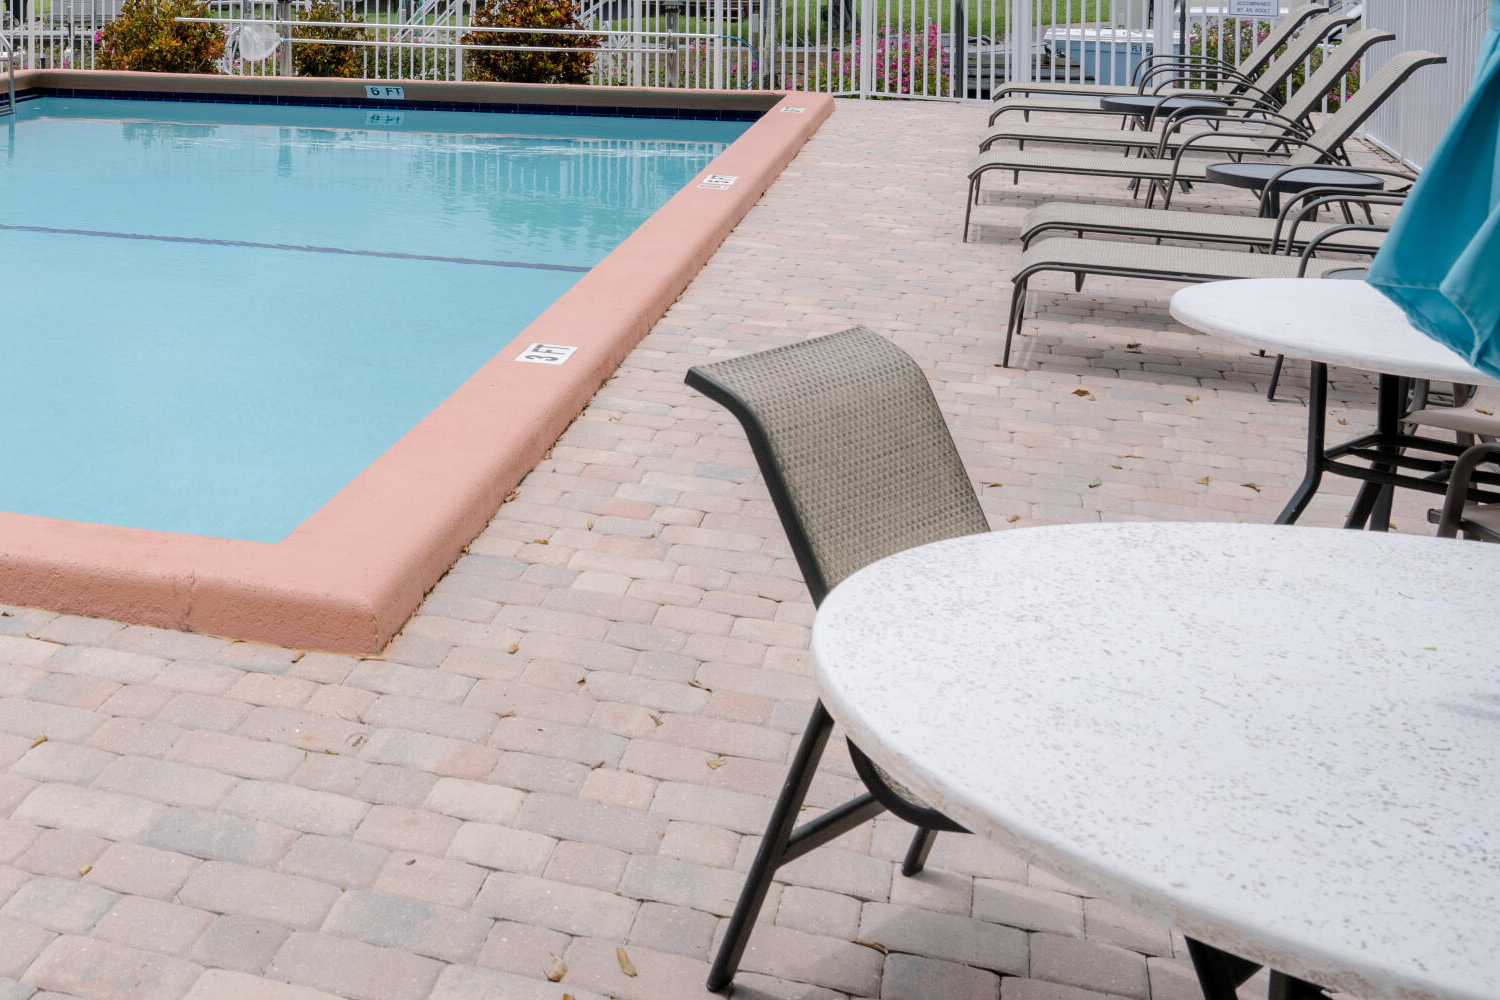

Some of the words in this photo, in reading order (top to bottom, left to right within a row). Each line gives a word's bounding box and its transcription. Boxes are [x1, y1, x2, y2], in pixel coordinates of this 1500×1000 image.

[370, 87, 380, 96] 6
[385, 87, 401, 96] FT
[531, 344, 571, 355] FT
[524, 354, 559, 362] 3
